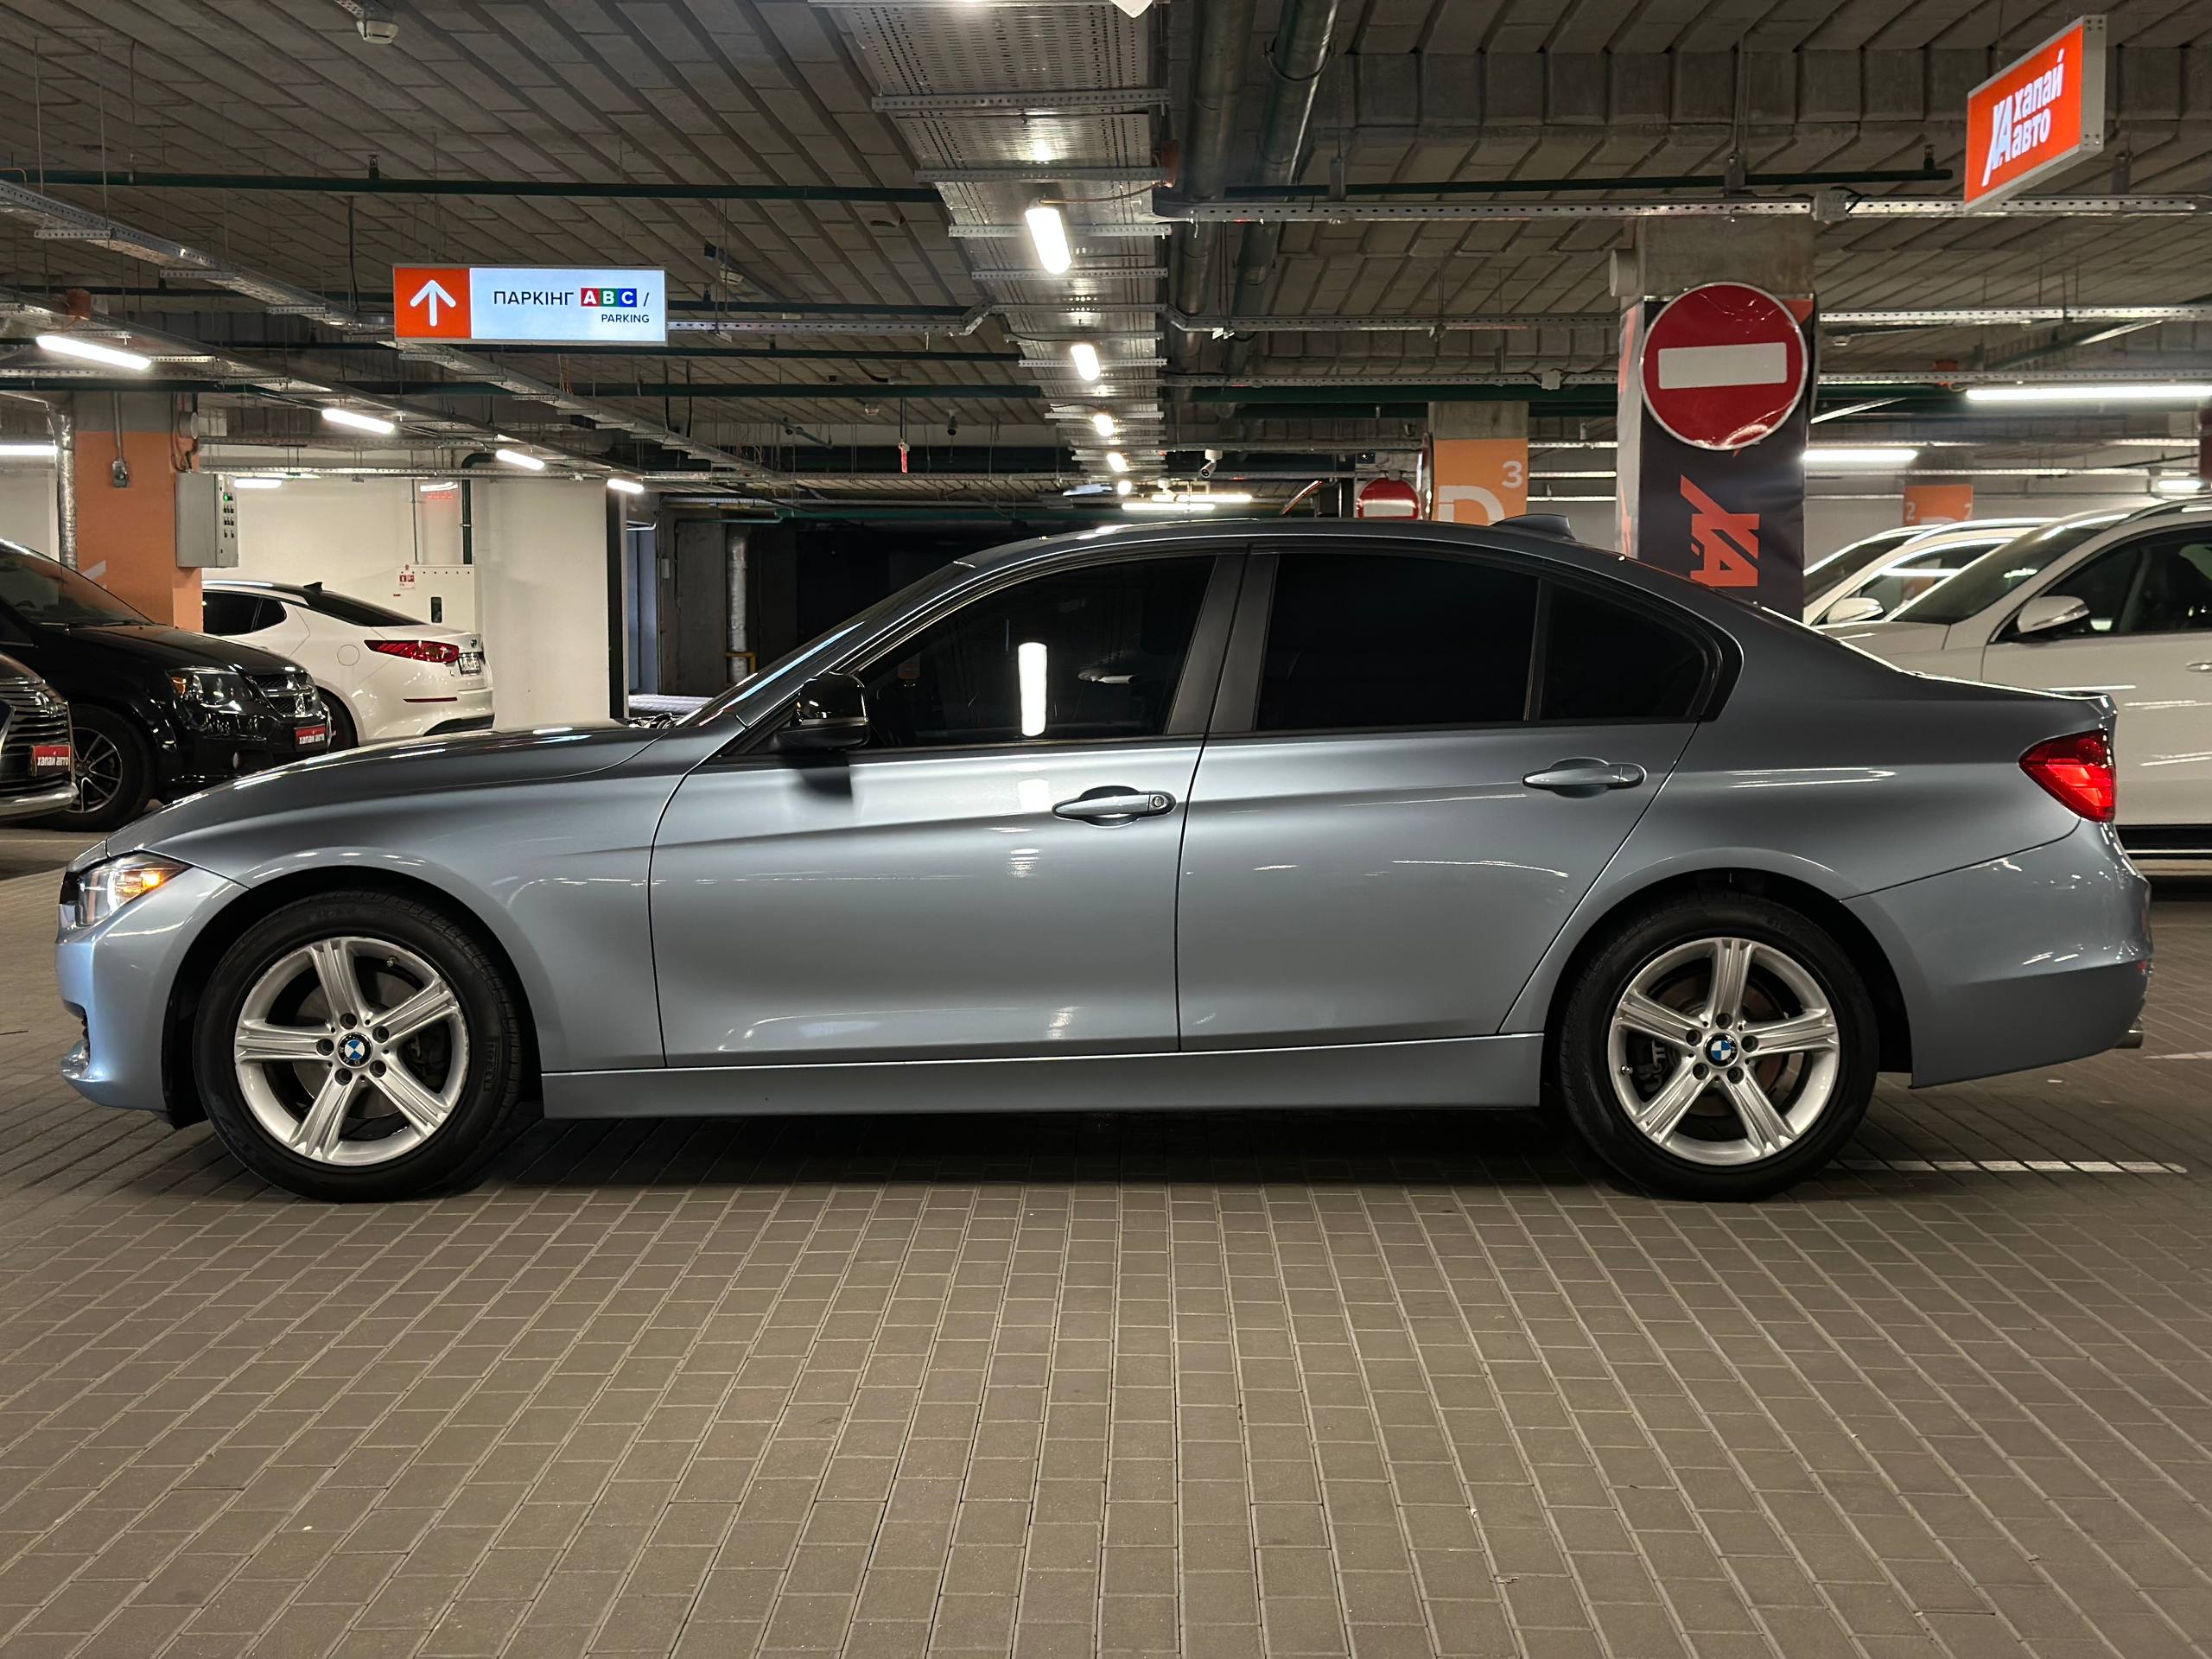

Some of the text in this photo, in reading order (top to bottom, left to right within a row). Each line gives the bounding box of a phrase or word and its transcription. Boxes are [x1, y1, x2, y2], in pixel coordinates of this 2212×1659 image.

[2012, 48, 2065, 124] хапай
[2011, 107, 2052, 159] авто
[493, 290, 575, 306] ПАРКІНГ
[601, 314, 650, 324] PARKING
[1501, 460, 1523, 489] 3
